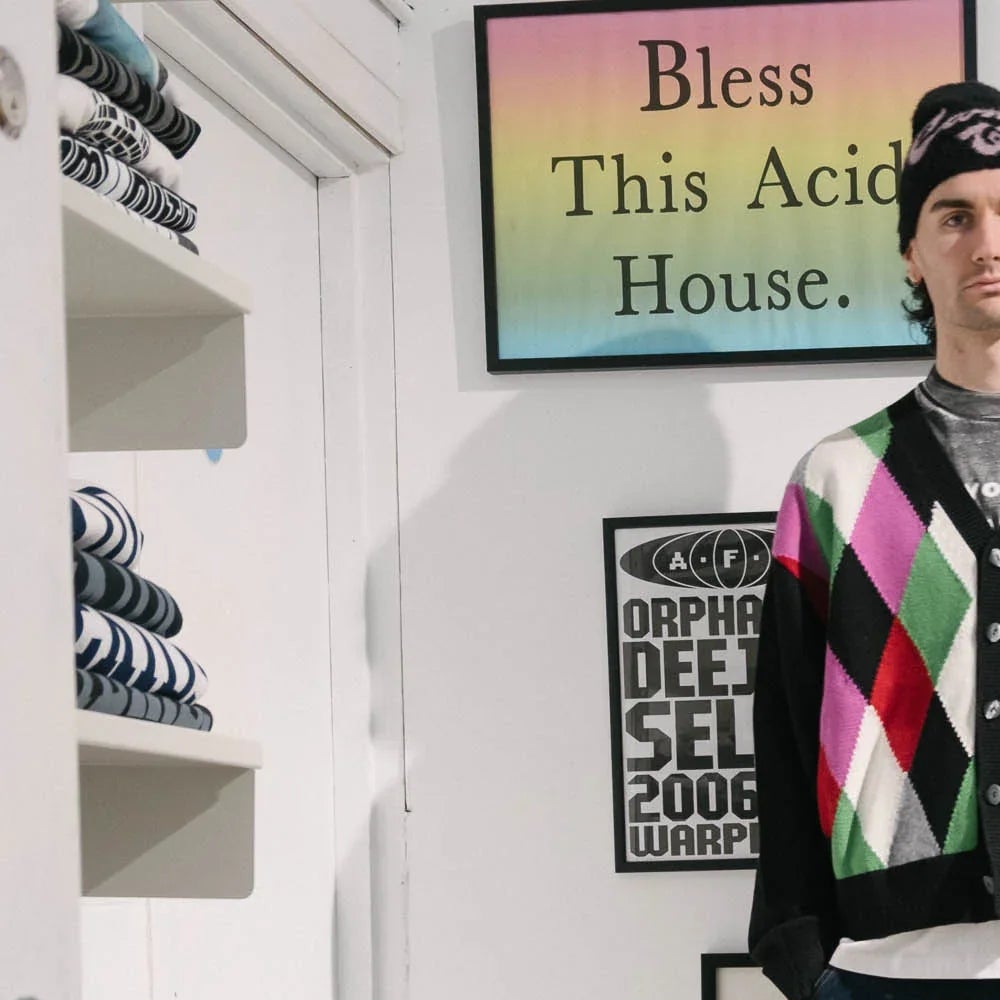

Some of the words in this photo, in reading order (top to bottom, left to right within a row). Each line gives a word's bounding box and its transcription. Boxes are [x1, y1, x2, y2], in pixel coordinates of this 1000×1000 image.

[638, 38, 814, 112] Bless
[551, 150, 709, 217] This
[746, 140, 902, 210] Acid
[613, 253, 851, 317] House.
[627, 771, 759, 823] 2006
